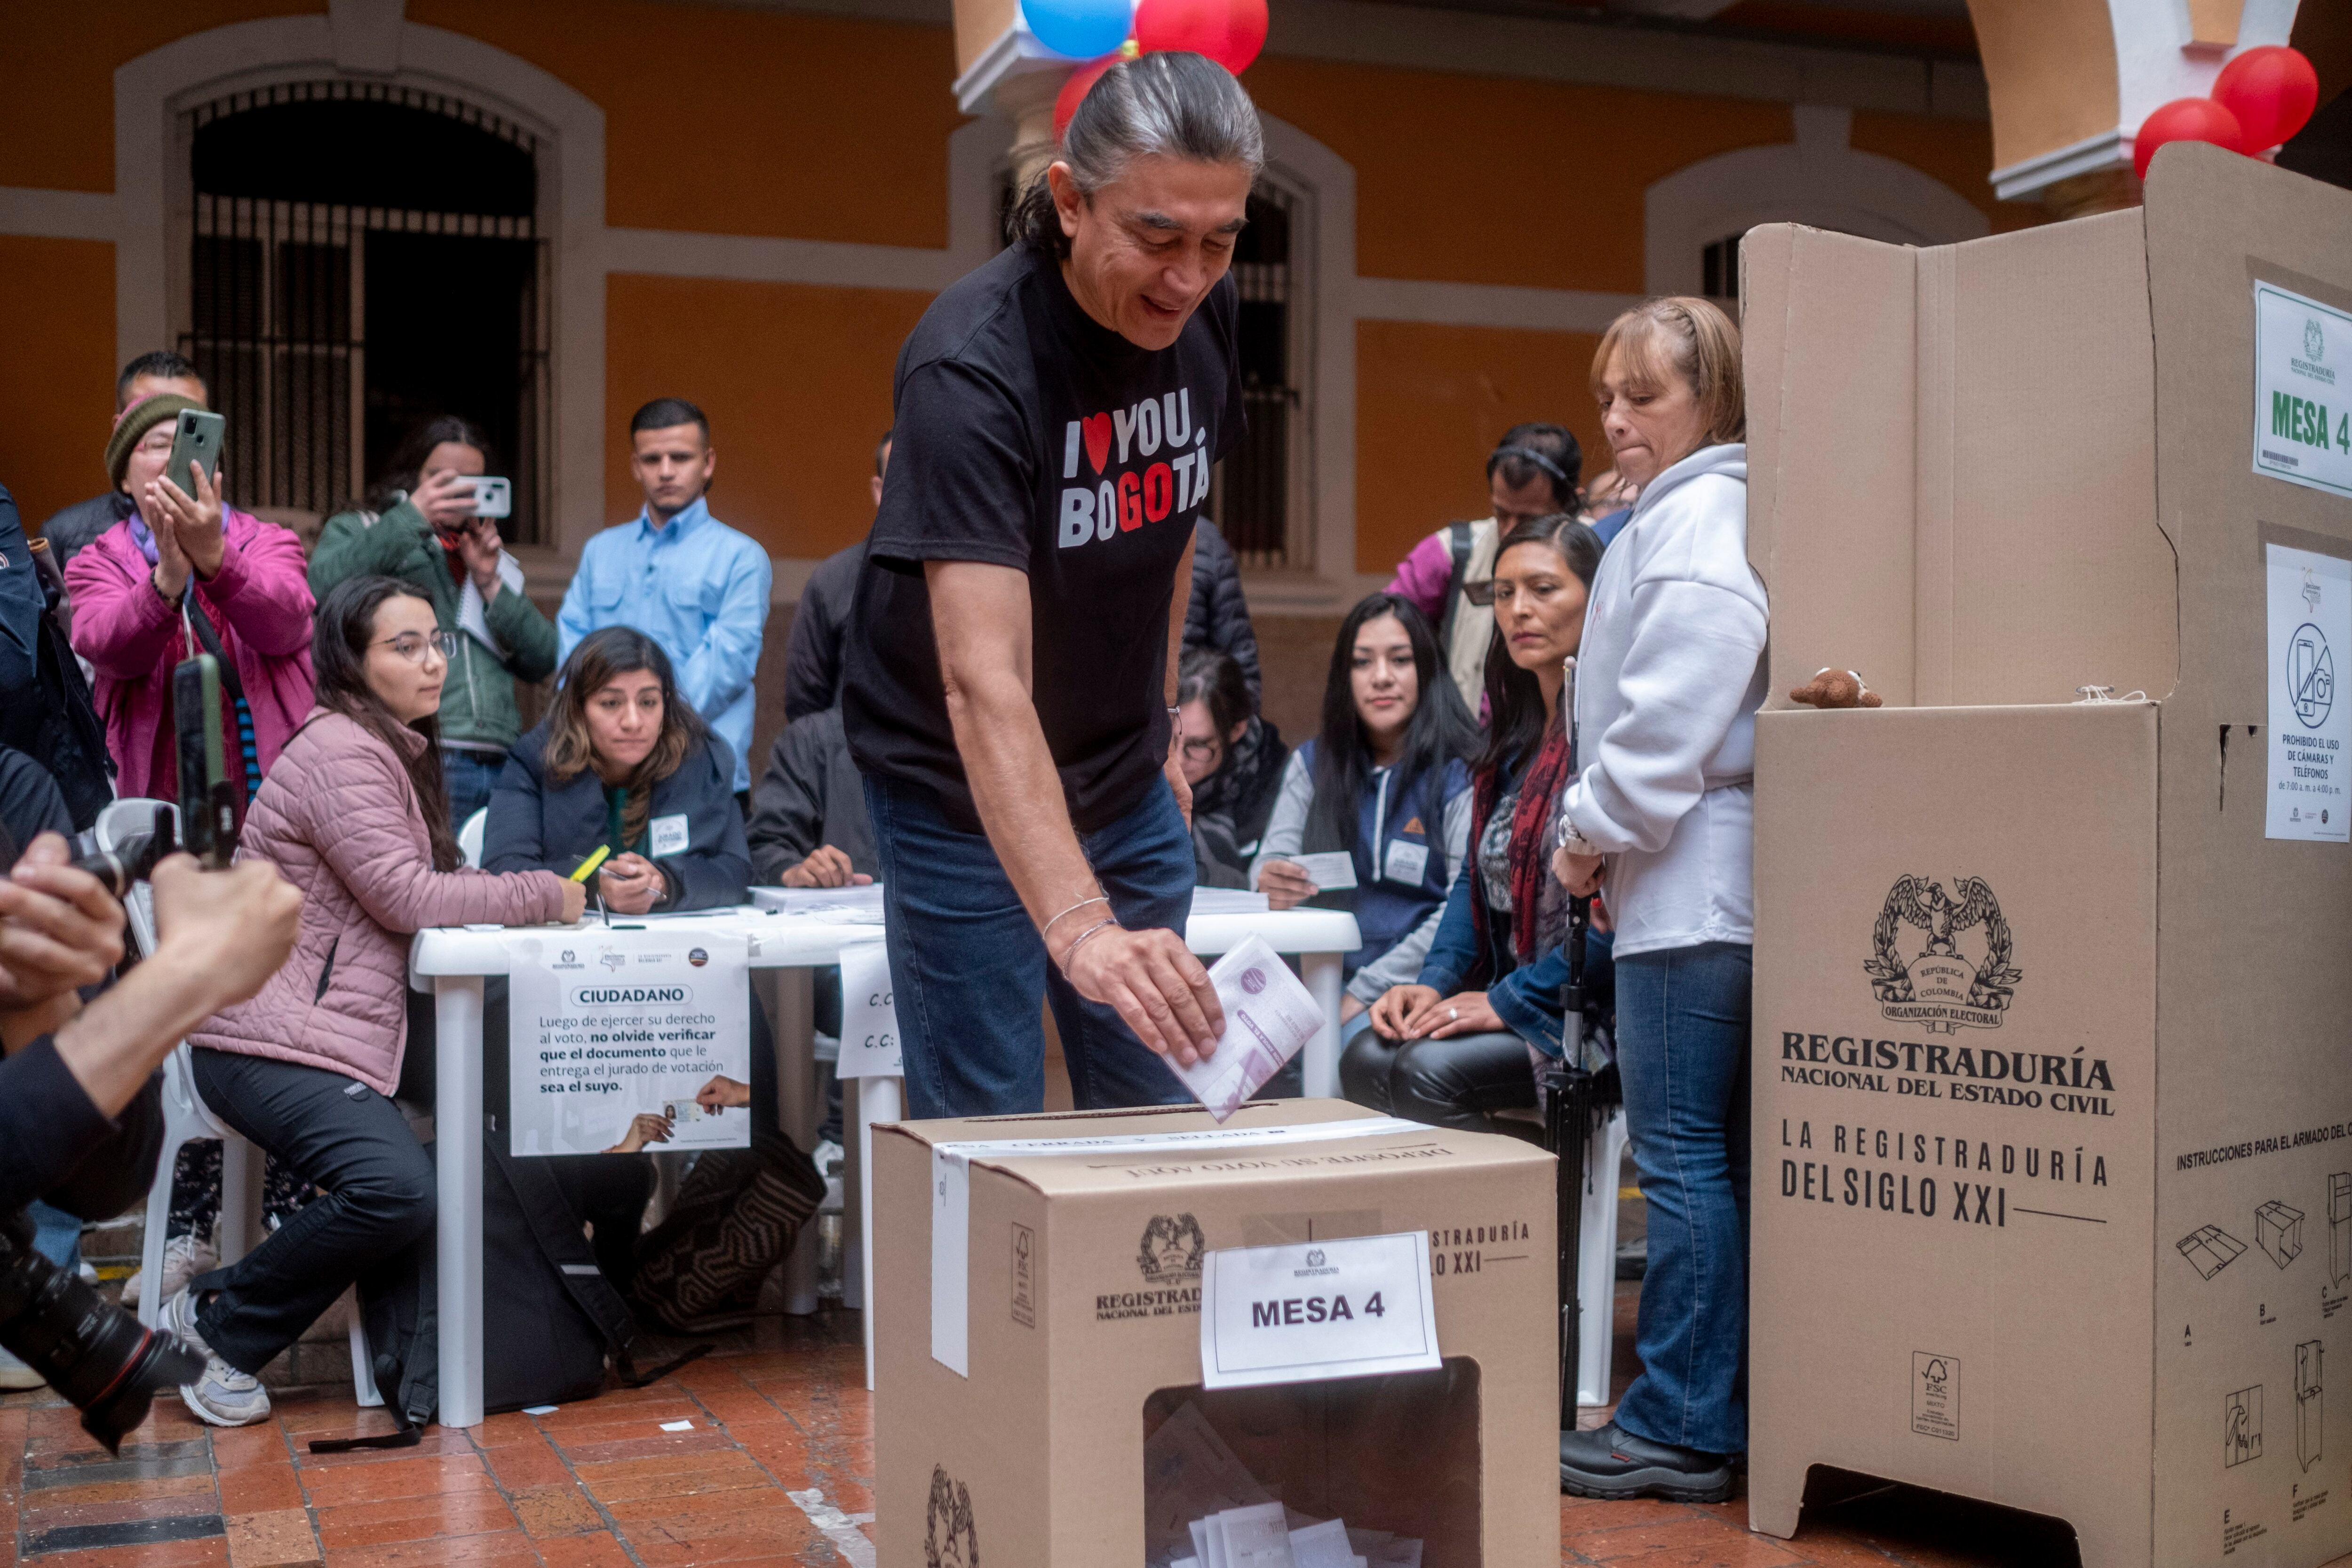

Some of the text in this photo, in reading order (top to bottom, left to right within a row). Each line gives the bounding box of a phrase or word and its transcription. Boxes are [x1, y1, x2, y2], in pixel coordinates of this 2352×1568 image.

[2291, 357, 2336, 379] REGISTRADURÍA
[2273, 390, 2350, 455] MESA 4
[1064, 421, 1081, 478] I
[1059, 427, 1209, 548] BOGOTÁ
[2283, 734, 2339, 750] PROHIBIDO EL USO
[2288, 749, 2334, 764] DE CÁMARAS Y
[2294, 765, 2328, 779] TELÉFONOS
[2279, 781, 2285, 789] de
[2287, 782, 2298, 790] 7:00
[2318, 784, 2328, 793] 4:00
[1920, 966, 1964, 979] REPÚBLICA
[580, 988, 684, 1003] CIUDADANO
[1920, 988, 1963, 1000] COLOMBIA
[540, 1016, 578, 1029] Luego
[582, 1015, 597, 1027] de
[601, 1014, 644, 1029] ejercer
[666, 1013, 715, 1026] derecho
[1240, 1014, 1254, 1029] VOTO
[1885, 1005, 1999, 1024] ORGANIZACIÓN ELECTORAL
[540, 1032, 550, 1044] al
[555, 1033, 587, 1044] voto,
[612, 1030, 654, 1042] olvide
[659, 1029, 715, 1040] verificar
[1258, 1034, 1274, 1053] ANULA
[540, 1045, 707, 1062] que el documento que le
[1782, 1031, 2116, 1092] REGISTRADURÍA
[540, 1060, 723, 1078] entrega el jurado de votación
[540, 1081, 622, 1094] sea el suyo.
[1781, 1066, 2115, 1116] NACIONAL DEL ESTADO CIVIL
[1168, 1132, 1260, 1140] SELLADA
[1321, 1148, 1455, 1164] DEPOSITE
[1783, 1118, 2108, 1187] LA REGISTRADURÍA
[2177, 1141, 2252, 1171] INSTRUCCIONES
[2255, 1137, 2279, 1156] PARA
[2280, 1135, 2291, 1150] EL
[2293, 1127, 2329, 1148] ARMADO
[2331, 1125, 2346, 1139] DEL
[1201, 1160, 1278, 1171] VOTO
[1281, 1157, 1318, 1167] SU
[1954, 1181, 2004, 1227] XXI
[1433, 1220, 1529, 1247] STRADURÍA
[1431, 1250, 1480, 1275] O XXI
[1097, 1287, 1201, 1310] REGISTRAD
[2322, 1285, 2327, 1298] C
[1097, 1307, 1149, 1321] NACIONAL
[1252, 1291, 1385, 1327] MESA 4
[2260, 1304, 2265, 1317] B
[2185, 1324, 2191, 1338] A
[1926, 1383, 1947, 1394] FSC
[2293, 1484, 2298, 1498] F
[2224, 1509, 2230, 1524] E
